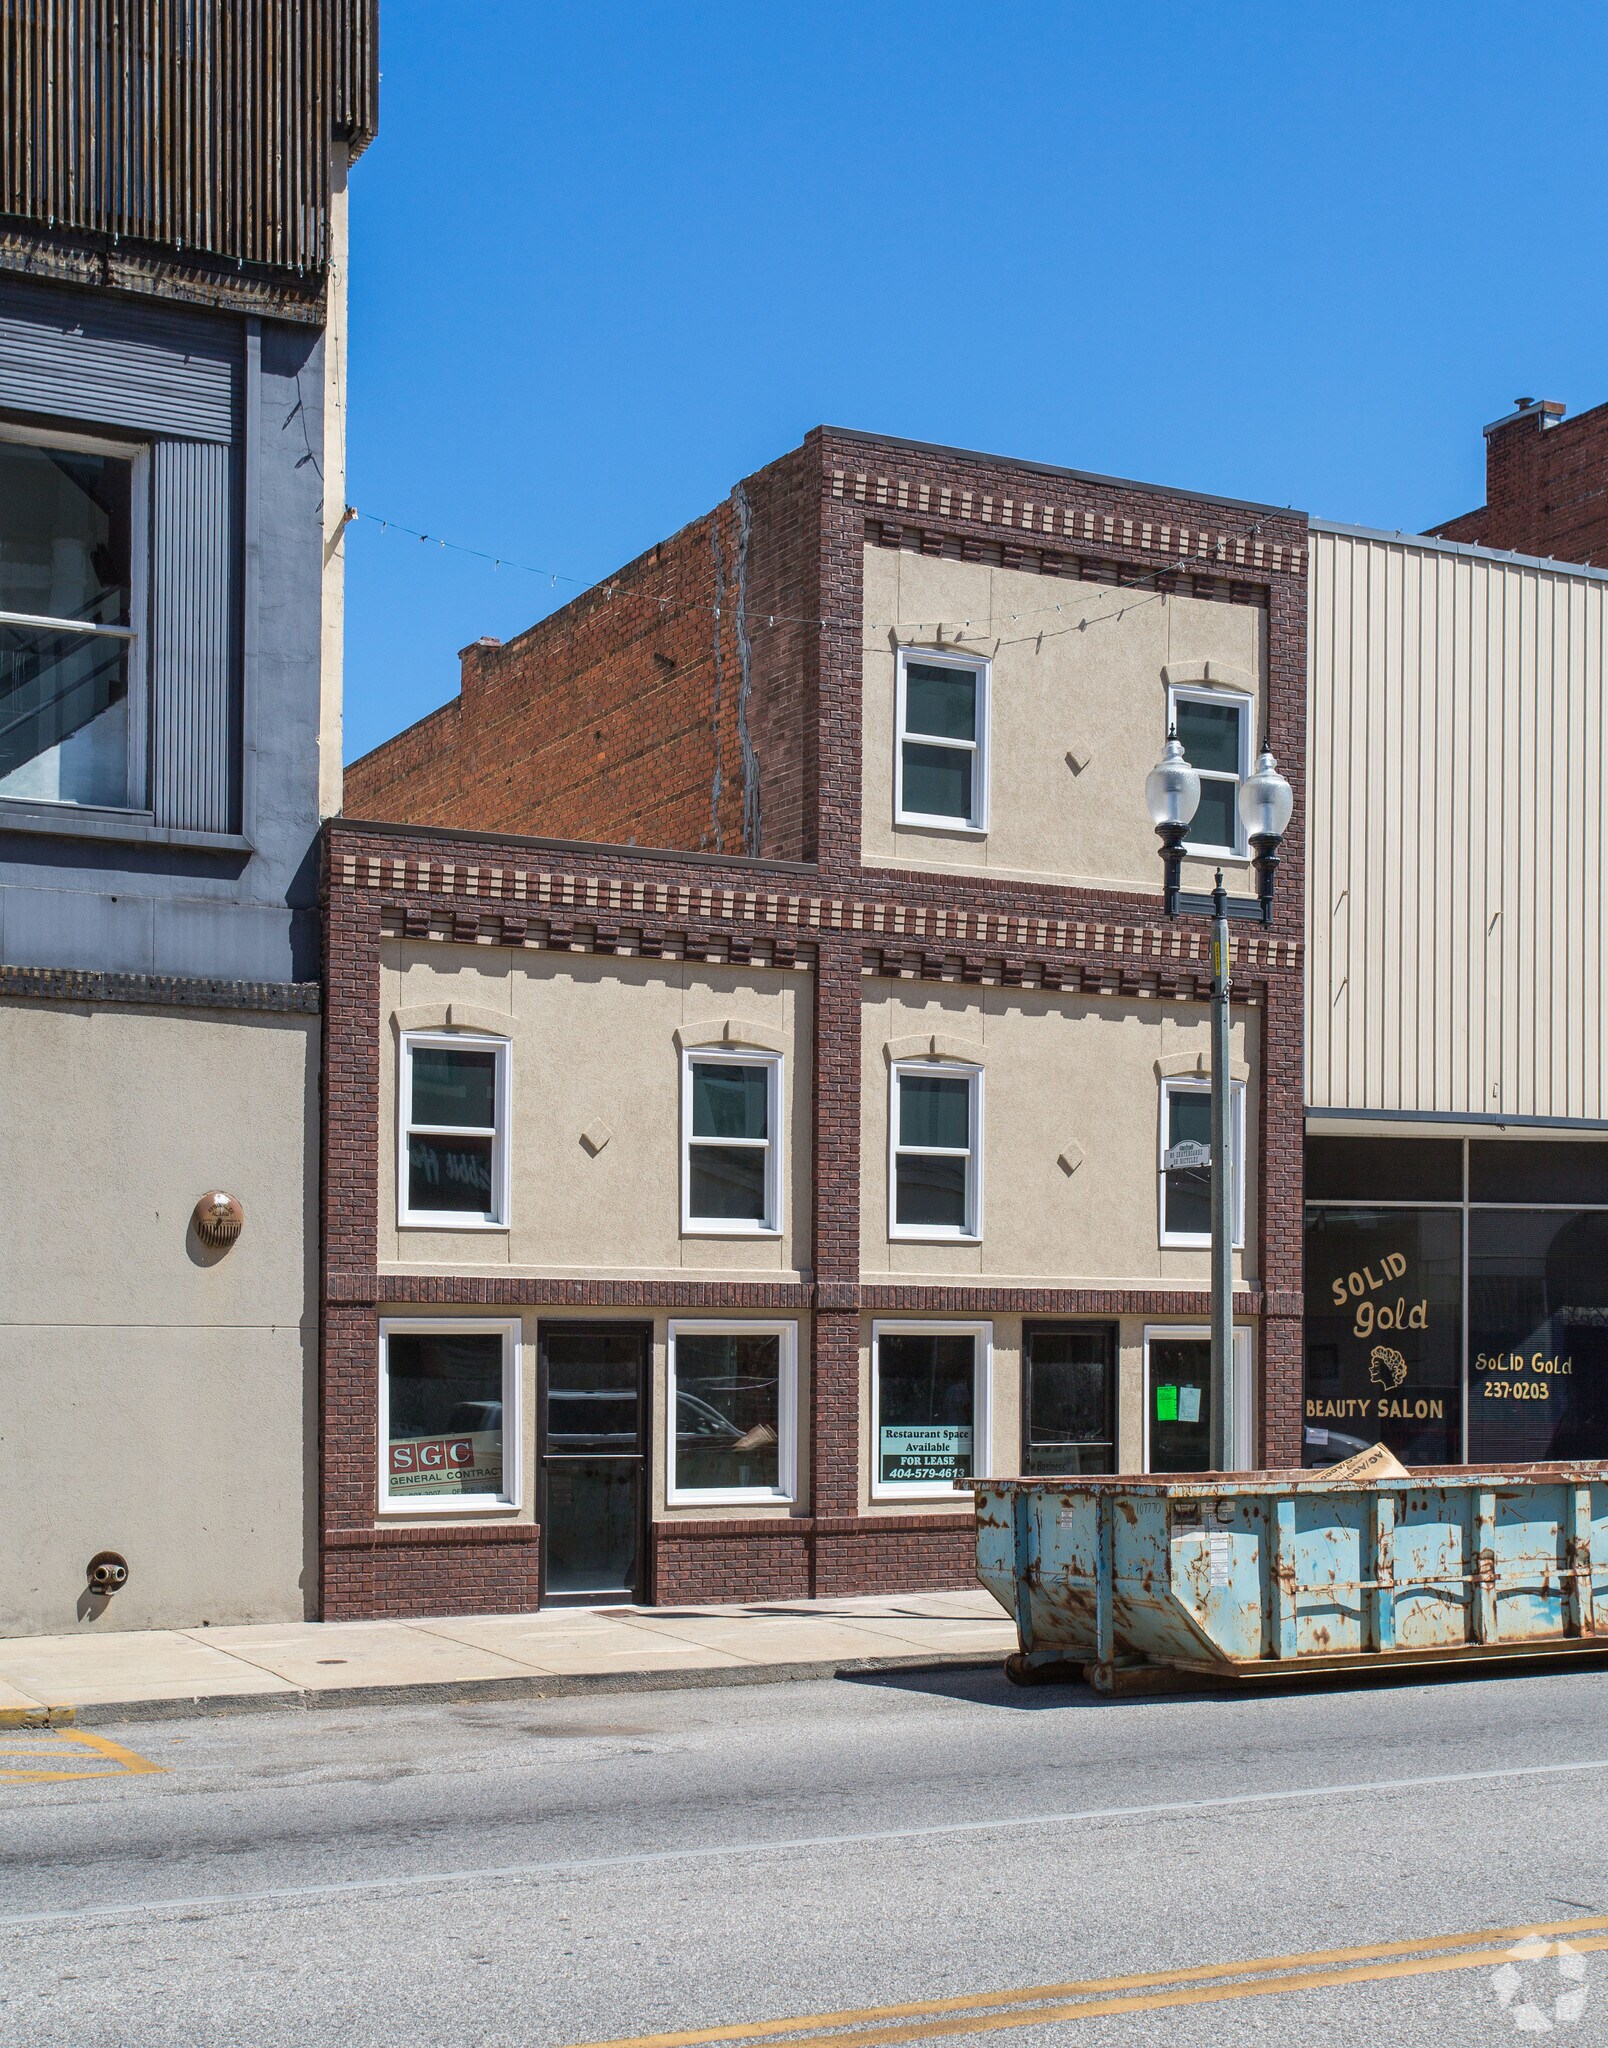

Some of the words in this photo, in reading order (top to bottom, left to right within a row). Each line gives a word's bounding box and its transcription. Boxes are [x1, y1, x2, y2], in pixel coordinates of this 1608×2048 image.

[1331, 1252, 1407, 1306] SOLID
[1353, 1297, 1429, 1338] gold
[1483, 1381, 1550, 1400] 237-0203
[1306, 1399, 1371, 1418] BEAUTY
[1377, 1399, 1443, 1419] SALON
[885, 1429, 941, 1439] Restaurant
[943, 1430, 969, 1441] Space
[905, 1442, 950, 1452] Available
[393, 1442, 470, 1468] SGC
[900, 1456, 922, 1466] FOR
[924, 1456, 955, 1466] LEASE
[390, 1474, 442, 1486] GENERAL
[889, 1468, 965, 1479] 404-579-4613
